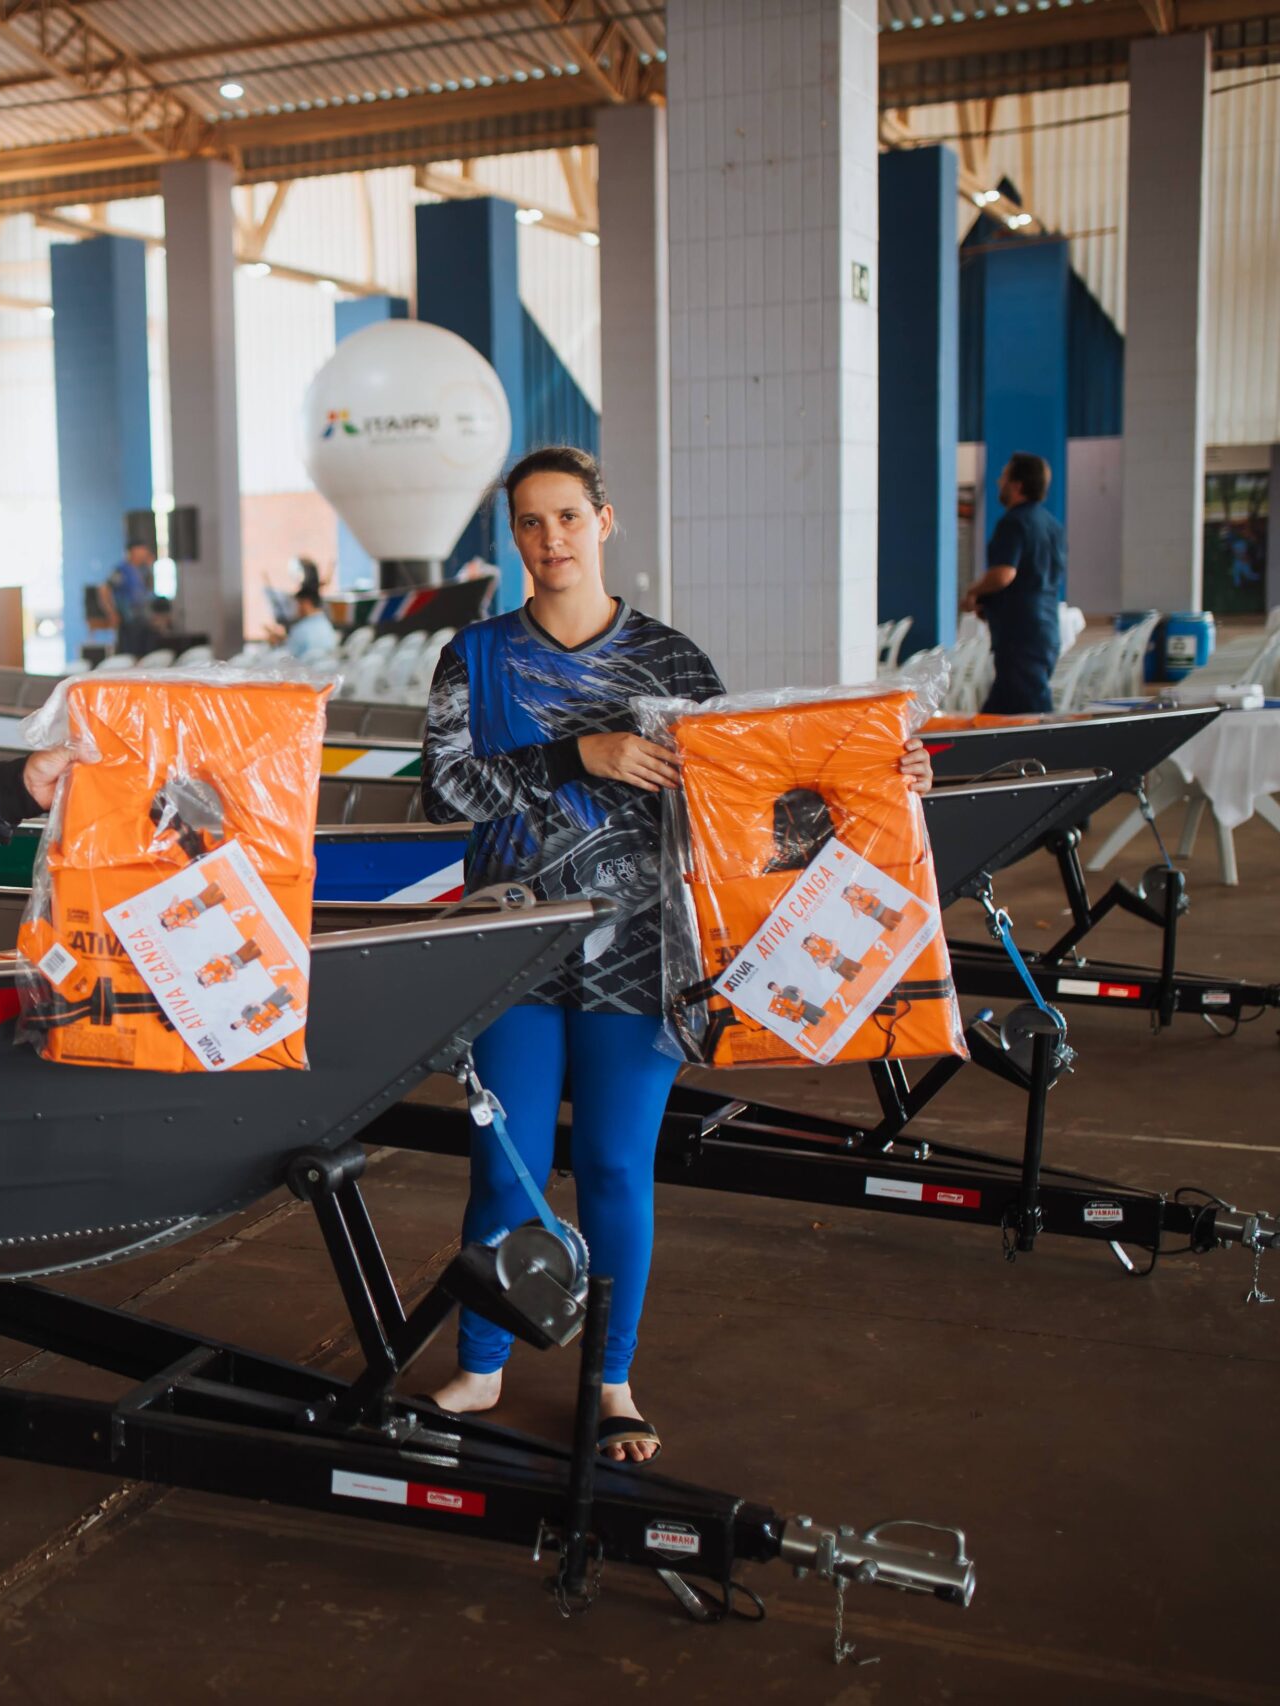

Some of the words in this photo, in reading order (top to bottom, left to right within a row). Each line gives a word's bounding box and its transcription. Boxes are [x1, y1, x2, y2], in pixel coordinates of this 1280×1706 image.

[756, 916, 794, 960] ATIVA
[789, 865, 835, 918] CANGA
[128, 928, 175, 985] CANGA
[874, 940, 895, 960] 3
[166, 987, 206, 1030] ATIVA
[832, 992, 854, 1014] 2
[660, 1532, 695, 1545] YAMAHA
